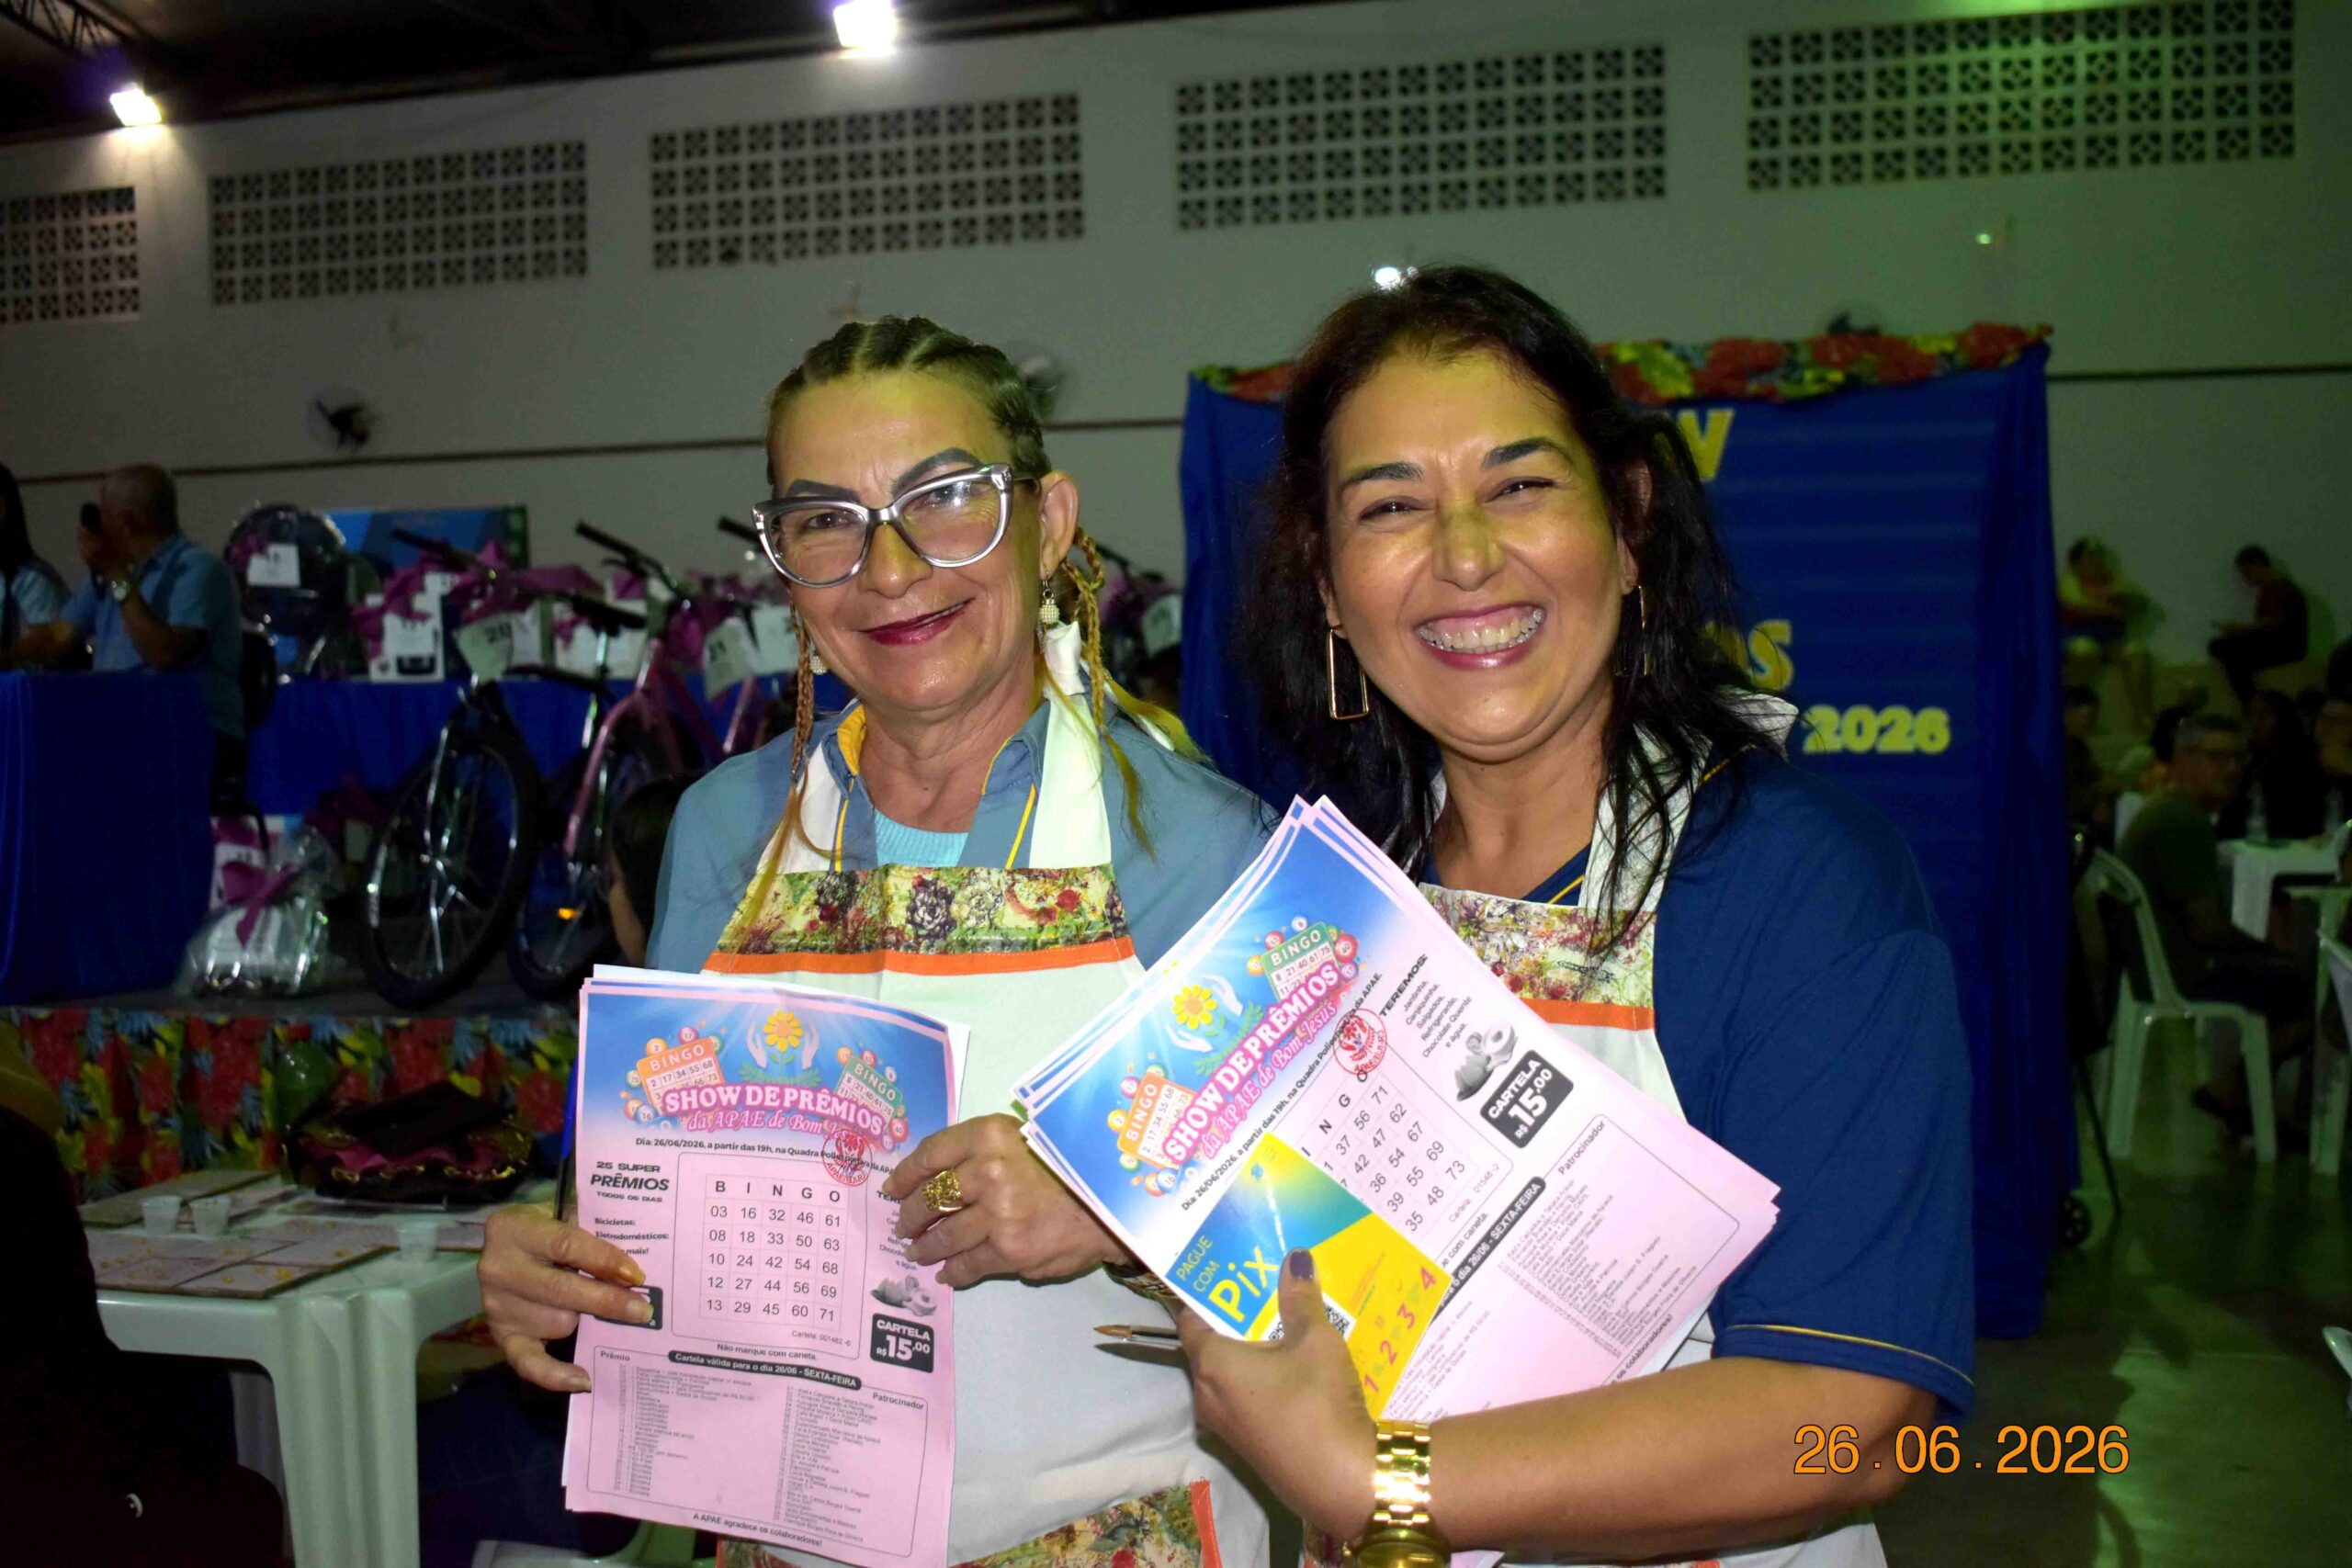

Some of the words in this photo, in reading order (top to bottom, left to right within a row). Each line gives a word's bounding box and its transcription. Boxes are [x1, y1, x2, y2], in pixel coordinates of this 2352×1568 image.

[1803, 705, 1951, 753] 2026
[1269, 930, 1322, 966] BINGO
[1379, 953, 1428, 1017] TEREMOS:
[1422, 1022, 1451, 1057] Chocolate
[1449, 995, 1471, 1022] Quente
[650, 1044, 705, 1072] BINGO
[1164, 1082, 1227, 1162] SHOW
[1216, 1051, 1255, 1092] DE
[1241, 963, 1341, 1059] PRÊMIOS
[1199, 1131, 1224, 1158] da
[1214, 1082, 1261, 1141] APAE
[1253, 1064, 1275, 1087] de
[1273, 1035, 1304, 1070] Bom
[1301, 1000, 1339, 1043] Jesus
[854, 1063, 897, 1101] BINGO
[1182, 1194, 1197, 1211] Dia:
[1241, 1126, 1263, 1150] partir
[1261, 1112, 1274, 1128] das
[1287, 1088, 1297, 1099] na
[1295, 1057, 1319, 1089] Quadra
[1352, 996, 1364, 1009] da
[1362, 972, 1381, 998] APAE.
[1318, 1120, 1332, 1134] N
[1337, 1093, 1351, 1109] G
[1355, 1068, 1369, 1083] O
[1487, 1057, 1541, 1119] CARTELA
[665, 1085, 742, 1112] SHOW
[745, 1085, 781, 1107] DE
[784, 1087, 886, 1136] PRÊMIOS
[688, 1111, 708, 1133] da
[707, 1110, 766, 1133] APAE
[767, 1109, 786, 1130] de
[789, 1115, 824, 1135] Bom
[1125, 1081, 1158, 1142] BINGO
[1334, 1135, 1353, 1155] 37
[1352, 1110, 1372, 1130] 56
[1371, 1085, 1389, 1104] 71
[636, 1137, 653, 1147] Dia:
[714, 1142, 740, 1153] partir
[741, 1143, 756, 1153] das
[788, 1147, 820, 1158] Quadra
[1351, 1154, 1370, 1174] 42
[1369, 1129, 1388, 1148] 47
[1387, 1102, 1407, 1122] 62
[1368, 1173, 1387, 1192] 36
[1386, 1147, 1406, 1168] 54
[1406, 1122, 1425, 1142] 67
[1558, 1121, 1605, 1174] Patrocinador
[591, 1173, 670, 1191] PRÊMIOS
[596, 1161, 614, 1170] 25
[618, 1163, 662, 1173] SUPER
[1385, 1191, 1406, 1212] 39
[1405, 1166, 1424, 1187] 55
[1425, 1140, 1445, 1161] 69
[596, 1191, 625, 1201] TODOS
[715, 1180, 726, 1193] B
[746, 1182, 752, 1194] I
[772, 1185, 784, 1197] N
[801, 1187, 813, 1200] G
[829, 1190, 841, 1202] O
[1405, 1211, 1424, 1231] 35
[1424, 1185, 1444, 1206] 48
[1446, 1159, 1465, 1179] 73
[710, 1205, 728, 1218] 03
[741, 1207, 757, 1220] 16
[768, 1209, 786, 1222] 32
[797, 1212, 814, 1224] 46
[825, 1214, 841, 1228] 61
[1447, 1239, 1464, 1258] com
[1462, 1209, 1488, 1240] caneta.
[1457, 1265, 1471, 1280] dia
[1468, 1242, 1489, 1266] 26/06
[1491, 1181, 1540, 1239] SEXTA-FEIRA
[709, 1229, 727, 1242] 08
[739, 1231, 755, 1243] 18
[767, 1233, 785, 1246] 33
[796, 1235, 813, 1247] 50
[823, 1237, 841, 1252] 63
[1176, 1235, 1212, 1280] PAGUE
[708, 1253, 726, 1266] 10
[736, 1255, 753, 1267] 24
[765, 1256, 783, 1269] 42
[795, 1258, 811, 1271] 54
[822, 1261, 839, 1275] 68
[1193, 1259, 1219, 1293] COM
[1207, 1244, 1280, 1322] Pix
[707, 1277, 724, 1289] 12
[735, 1278, 752, 1291] 27
[763, 1280, 781, 1292] 44
[793, 1281, 810, 1295] 56
[820, 1285, 837, 1299] 69
[707, 1300, 723, 1312] 13
[734, 1301, 752, 1314] 29
[763, 1303, 780, 1316] 45
[791, 1304, 809, 1318] 60
[820, 1308, 835, 1323] 71
[876, 1318, 932, 1340] CARTELA
[1361, 1374, 1380, 1393] 1
[1376, 1339, 1401, 1363] 2
[1394, 1303, 1419, 1328] 3
[1413, 1267, 1438, 1292] 4
[600, 1349, 630, 1362] Prêmio
[717, 1343, 734, 1353] Não
[734, 1346, 766, 1358] marque
[768, 1349, 786, 1358] com
[1616, 1369, 1626, 1379] os
[1625, 1314, 1673, 1369] colaboradores!
[674, 1352, 706, 1365] Cartela
[707, 1356, 731, 1369] válida
[731, 1361, 752, 1372] para
[759, 1363, 774, 1373] dia
[775, 1364, 797, 1376] 26/06
[804, 1367, 858, 1388] SEXTA-FEIRA
[872, 1392, 924, 1411] Patrocinador
[693, 1512, 700, 1521] A
[701, 1514, 722, 1525] APAE
[723, 1520, 758, 1534] agradece
[759, 1527, 769, 1535] os
[770, 1528, 823, 1549] colaboradores!
